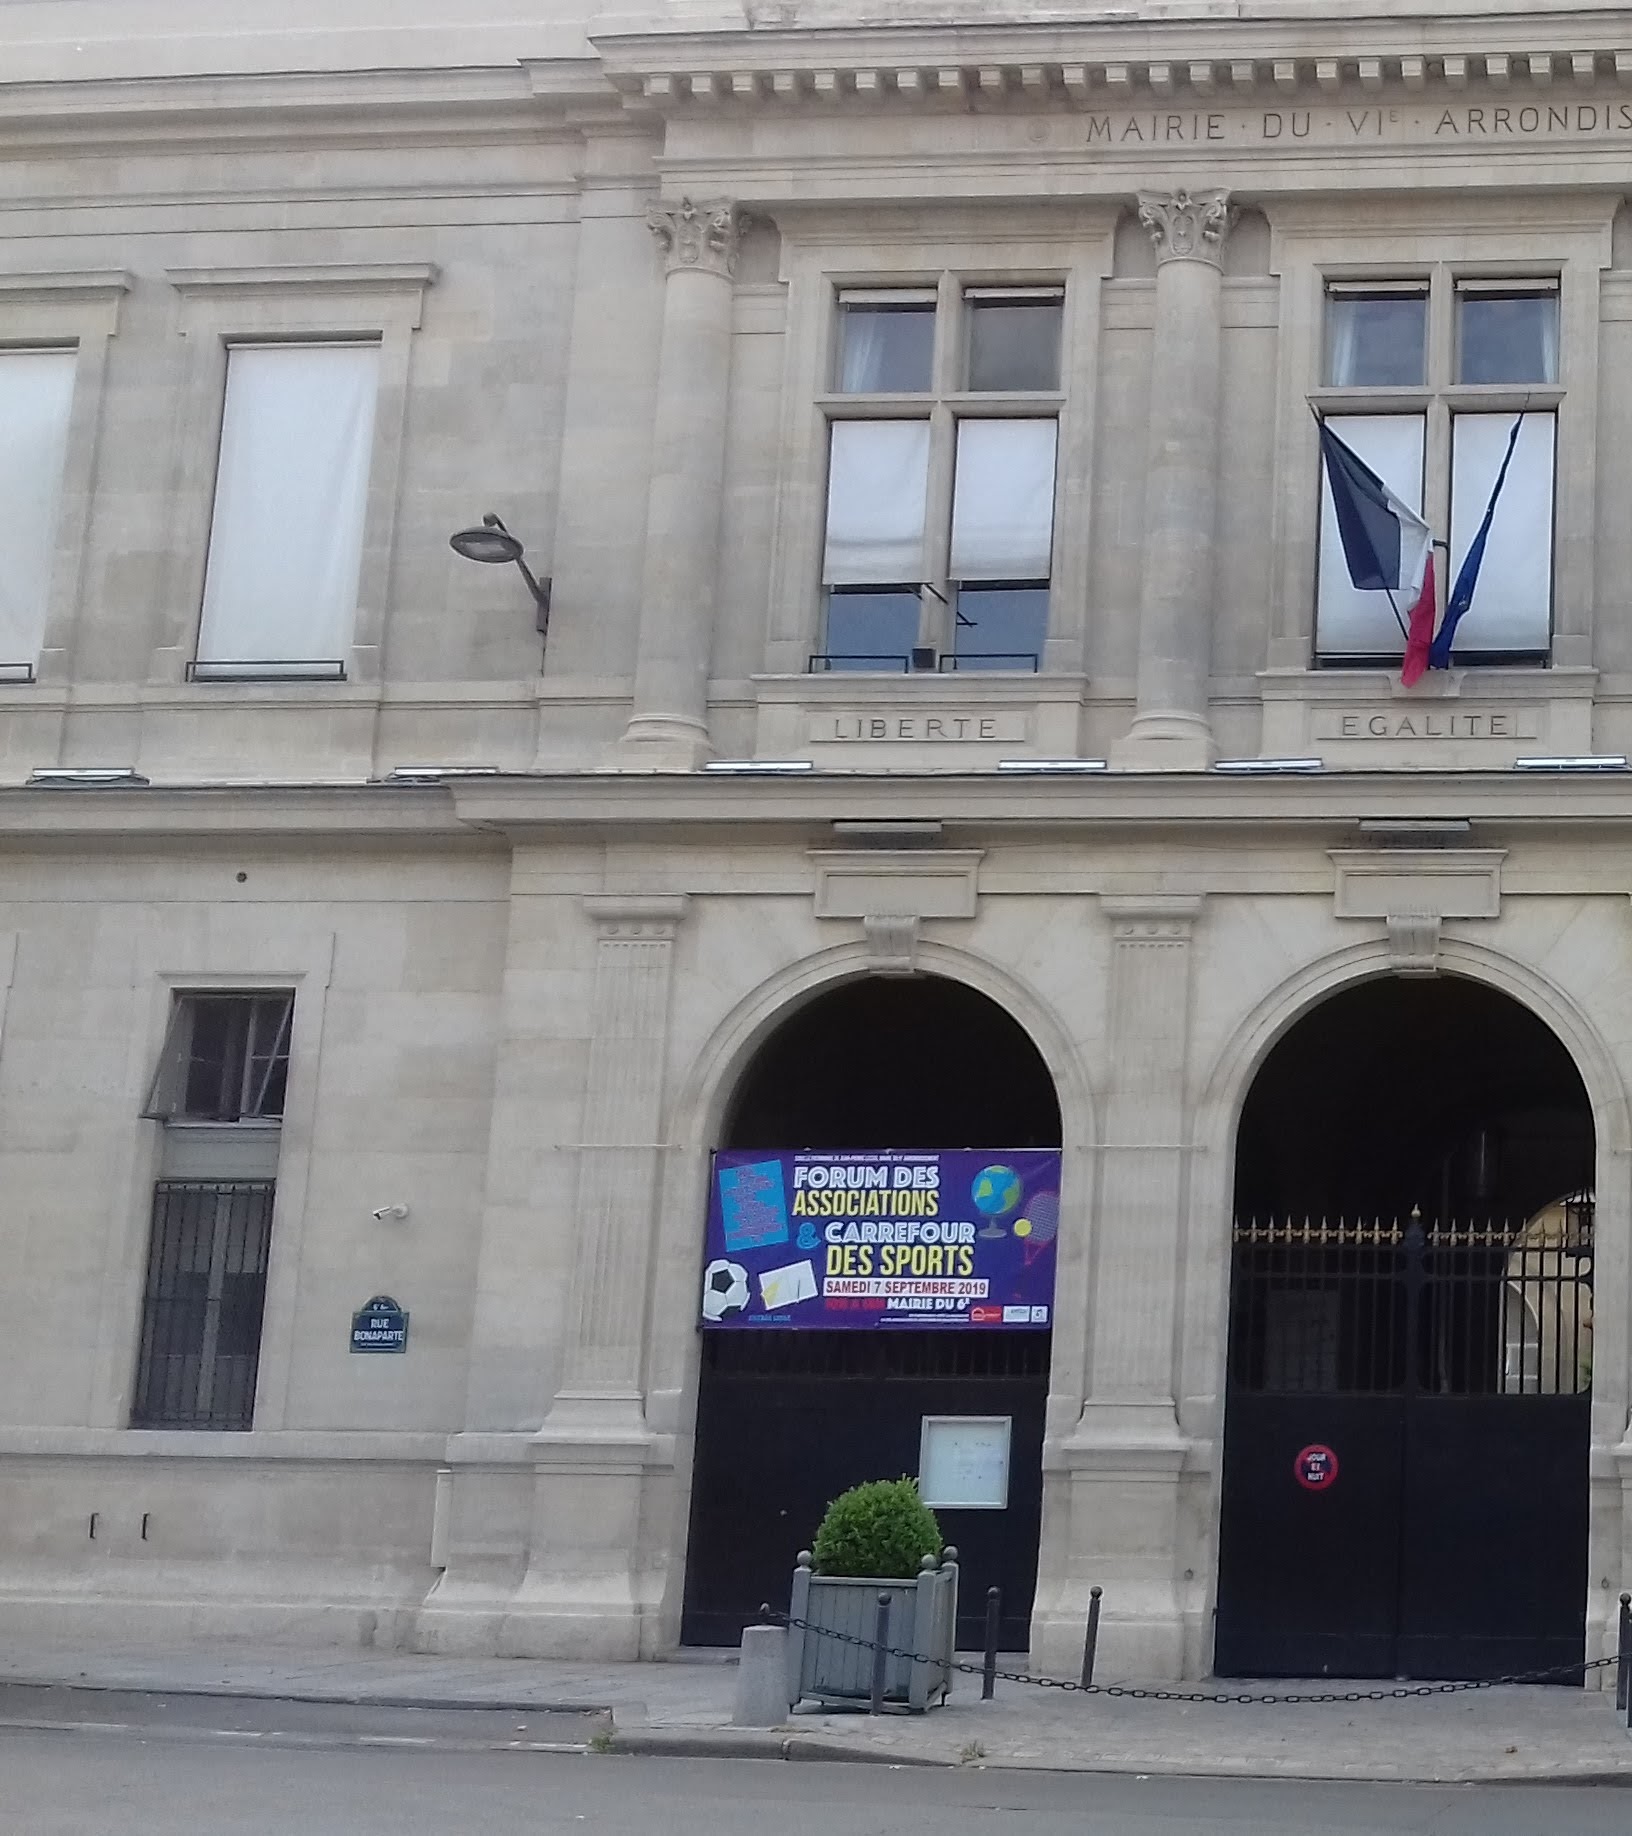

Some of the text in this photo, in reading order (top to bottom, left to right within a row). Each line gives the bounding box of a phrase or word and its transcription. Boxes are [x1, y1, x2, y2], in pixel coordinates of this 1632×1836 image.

[1085, 112, 1226, 143] MAIRIE
[1262, 112, 1312, 139] DU
[834, 716, 997, 741] LIBERTE
[1342, 714, 1509, 737] EGALITE
[793, 1165, 940, 1189] FORUM DES
[791, 1189, 940, 1216] ASSOCIATIONS
[797, 1221, 976, 1249] & CARREFOUR
[826, 1245, 975, 1276] DES SPORTS
[826, 1280, 986, 1295] SAMEDI 7 SEPTEMBRE 2019
[886, 1297, 933, 1310] MAIRIE
[935, 1297, 955, 1310] DU
[353, 1330, 404, 1341] BONAPARTE
[370, 1318, 390, 1329] RUE
